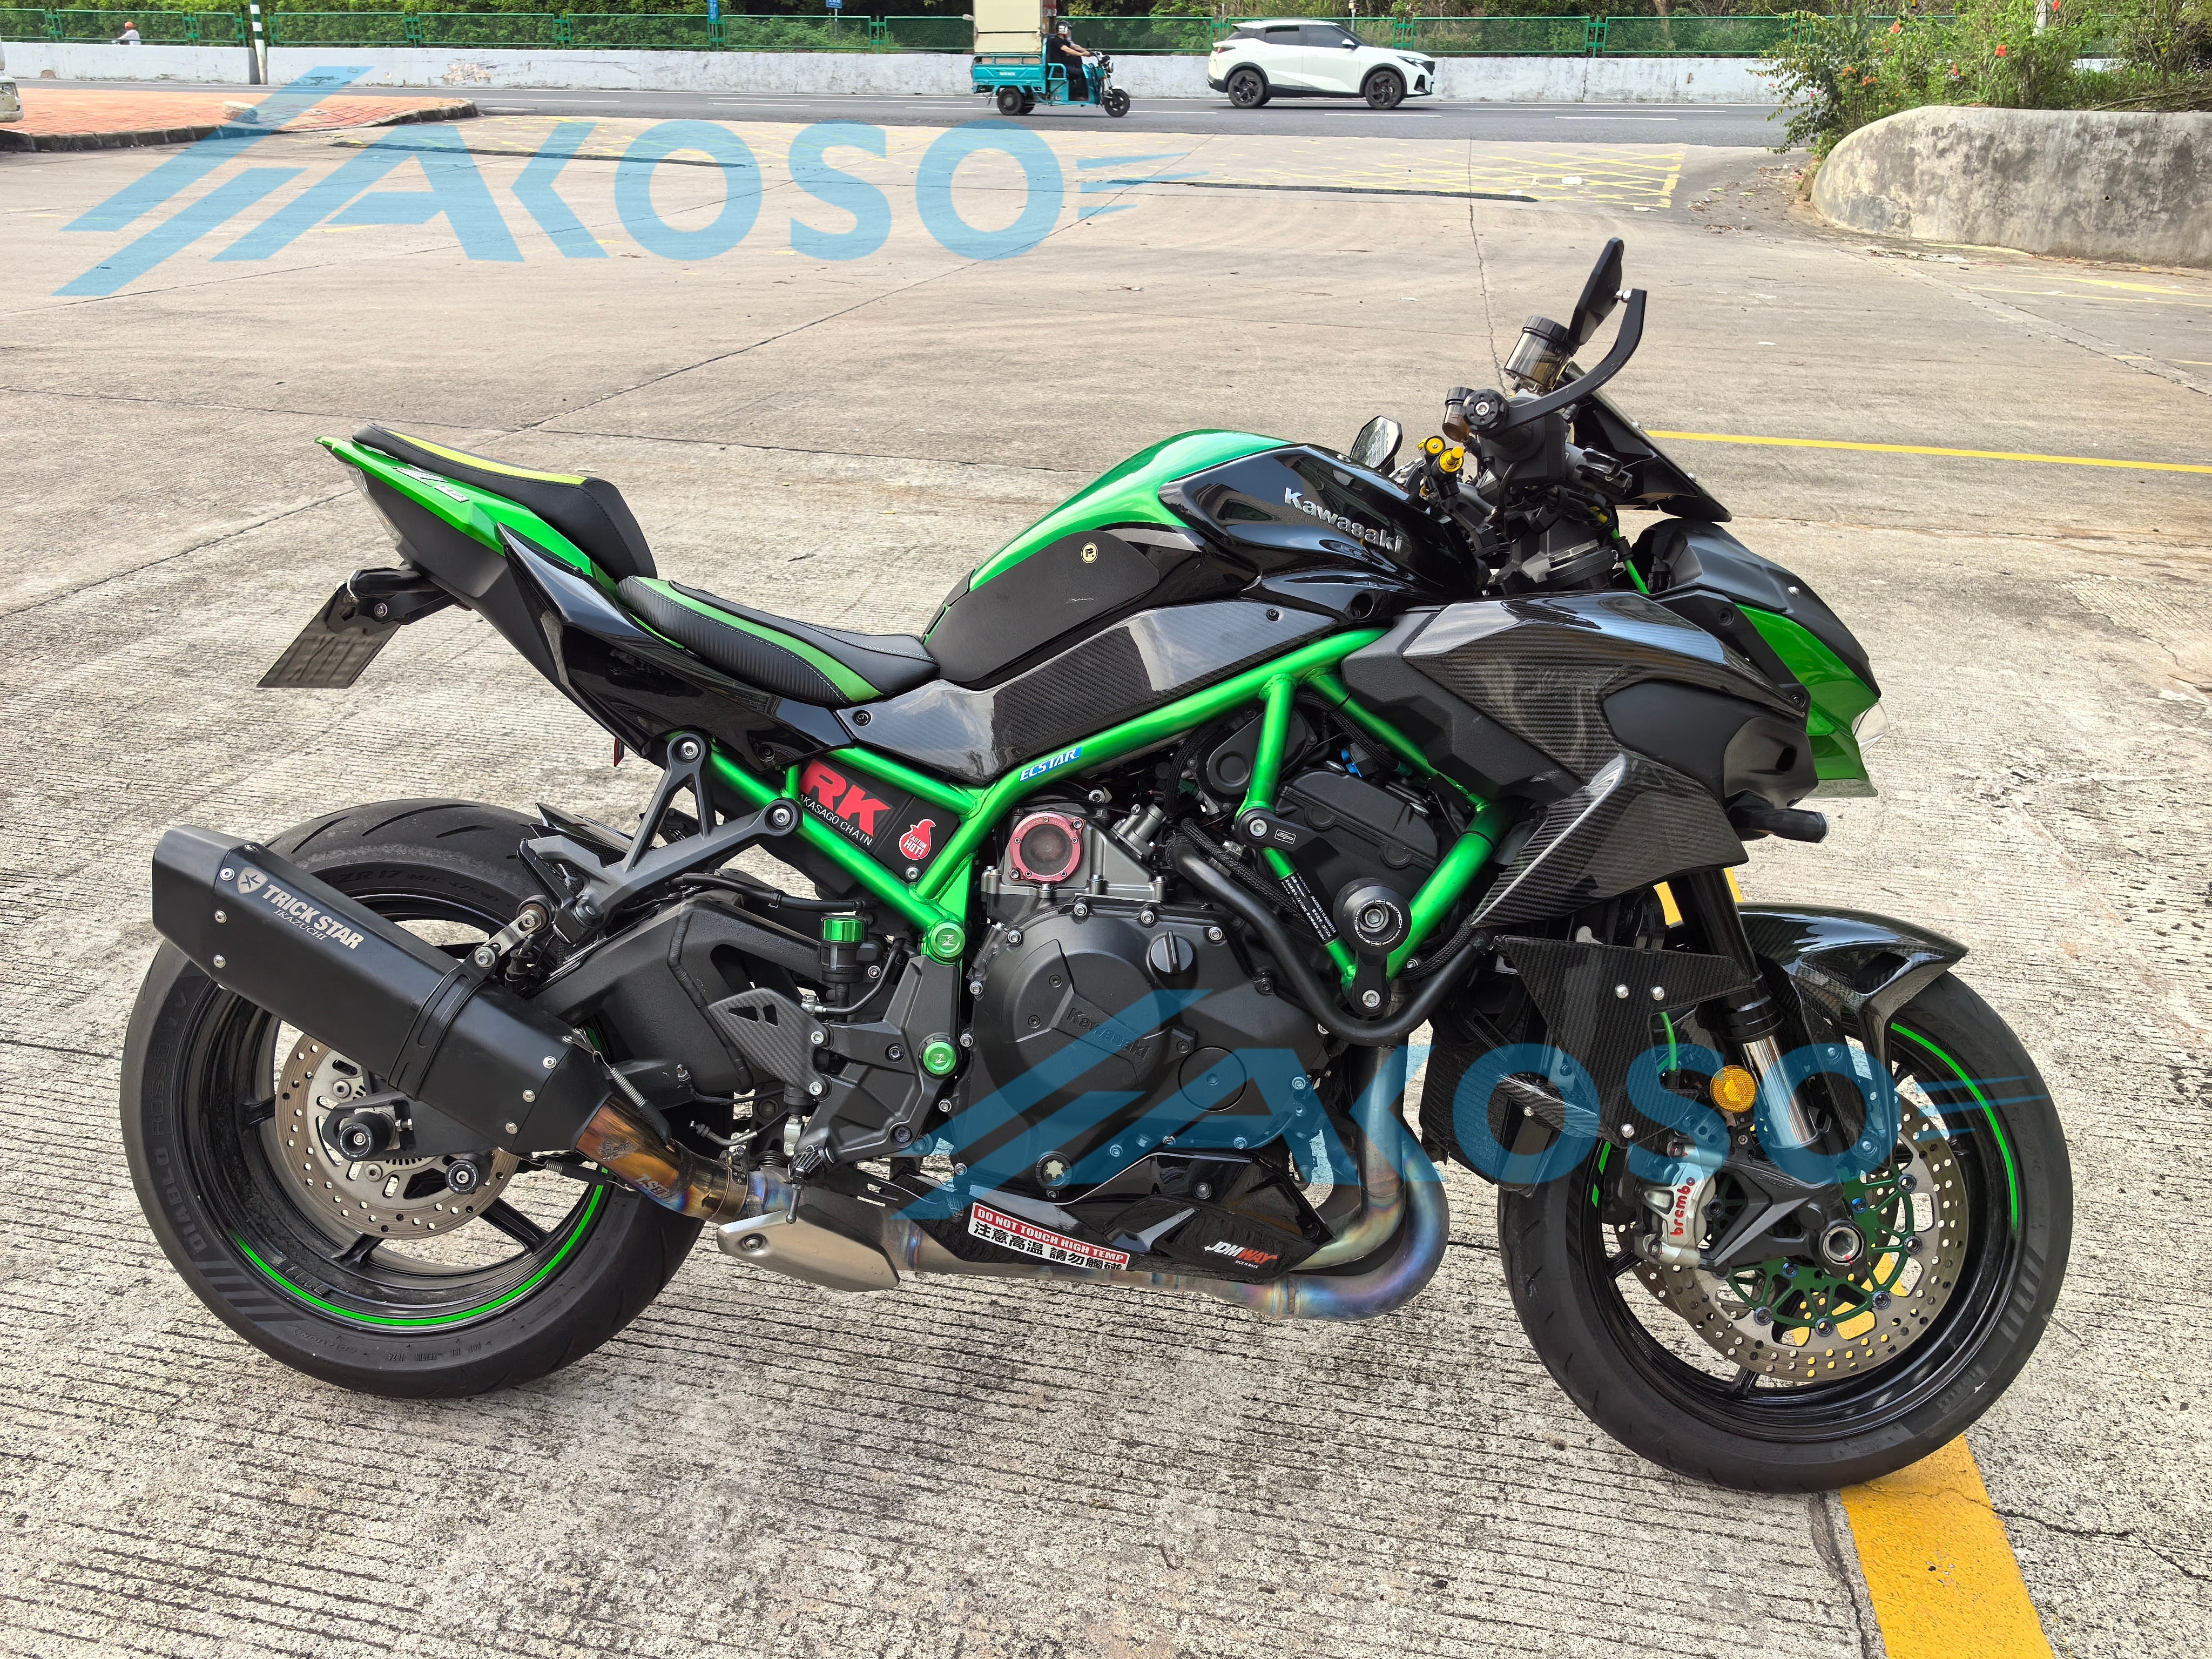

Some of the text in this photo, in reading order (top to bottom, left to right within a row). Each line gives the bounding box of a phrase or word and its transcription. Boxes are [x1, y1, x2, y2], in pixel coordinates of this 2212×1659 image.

[1285, 487, 1402, 554] Kawasaki
[1020, 748, 1081, 781] ECSTAR
[800, 758, 891, 837] RK
[840, 821, 873, 846] CHAIN
[903, 839, 925, 859] HOT!
[909, 833, 928, 850] CAUTION
[262, 884, 365, 950] TRICK STAR
[274, 909, 327, 941] IKAZUCHI
[1067, 1008, 1150, 1060] Kawasaki
[1670, 1177, 1695, 1237] brembo
[977, 1208, 1125, 1261] DO NOT TOUCH HIGH TEMP
[1204, 1241, 1278, 1264] JDMWAY
